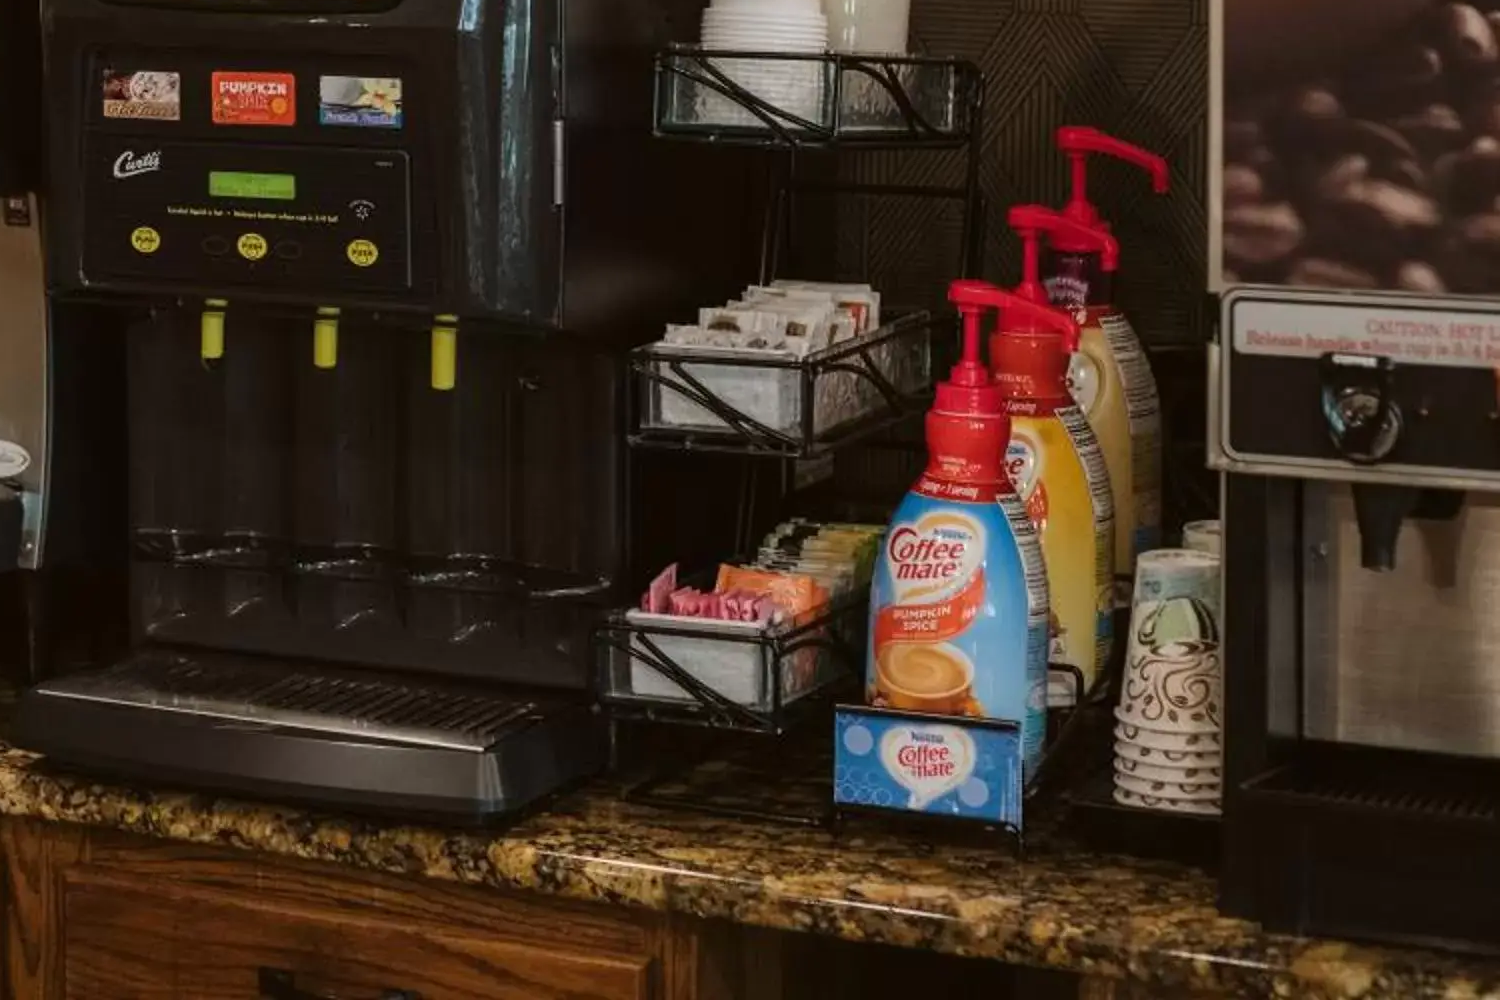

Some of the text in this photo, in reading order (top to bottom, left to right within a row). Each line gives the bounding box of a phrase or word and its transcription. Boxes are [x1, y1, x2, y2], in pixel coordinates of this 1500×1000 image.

[890, 527, 966, 563] Coffee
[896, 561, 957, 580] mate
[892, 605, 952, 620] PUMPKIN
[902, 619, 938, 631] SPICE
[898, 745, 950, 768] Coffee
